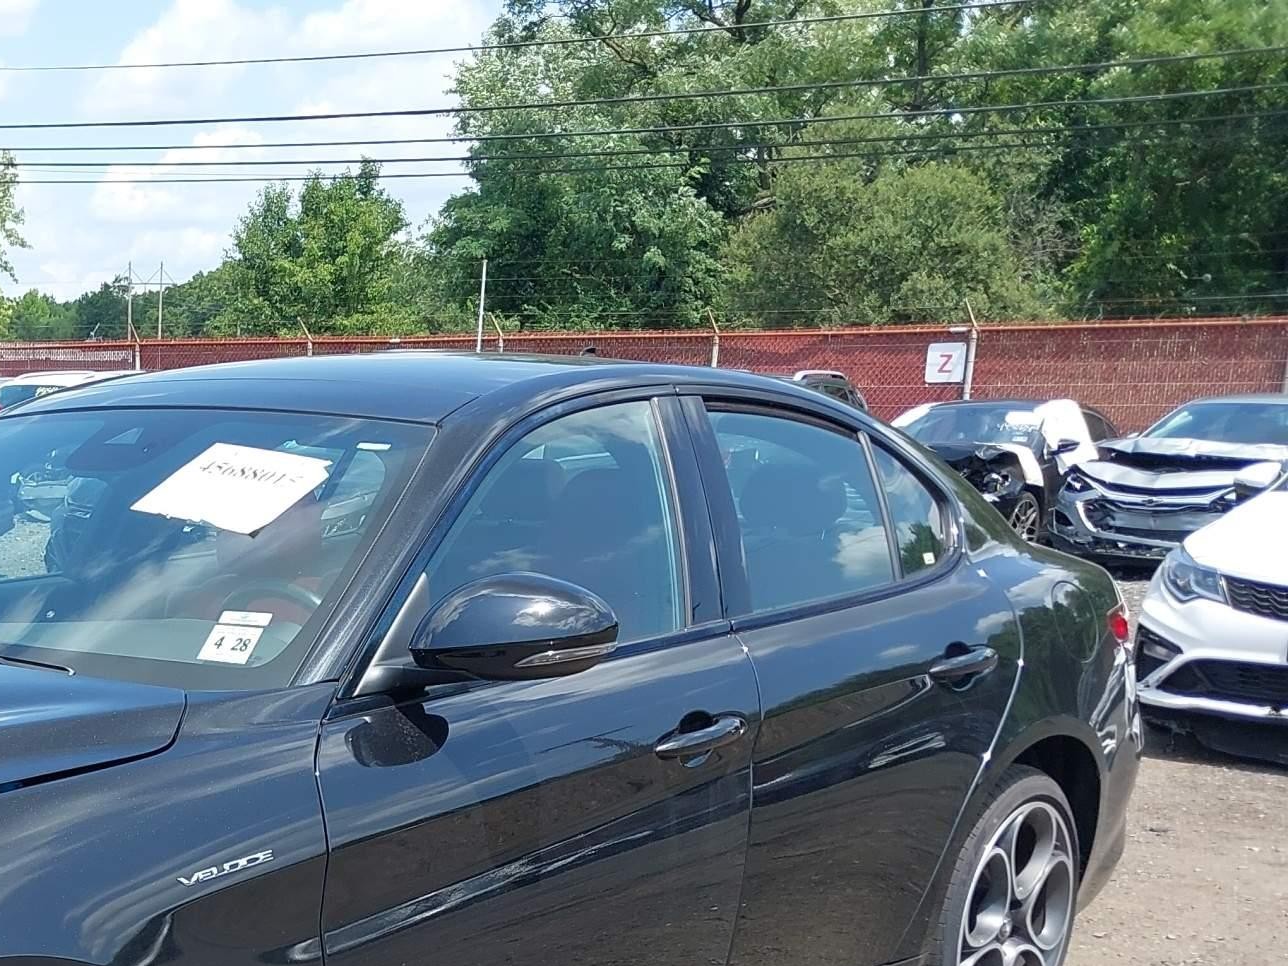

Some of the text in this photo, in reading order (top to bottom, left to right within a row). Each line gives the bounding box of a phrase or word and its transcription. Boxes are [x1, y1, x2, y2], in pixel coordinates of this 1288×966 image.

[937, 354, 953, 374] Z
[214, 636, 251, 652] 4 28
[176, 849, 274, 887] VELOCE
